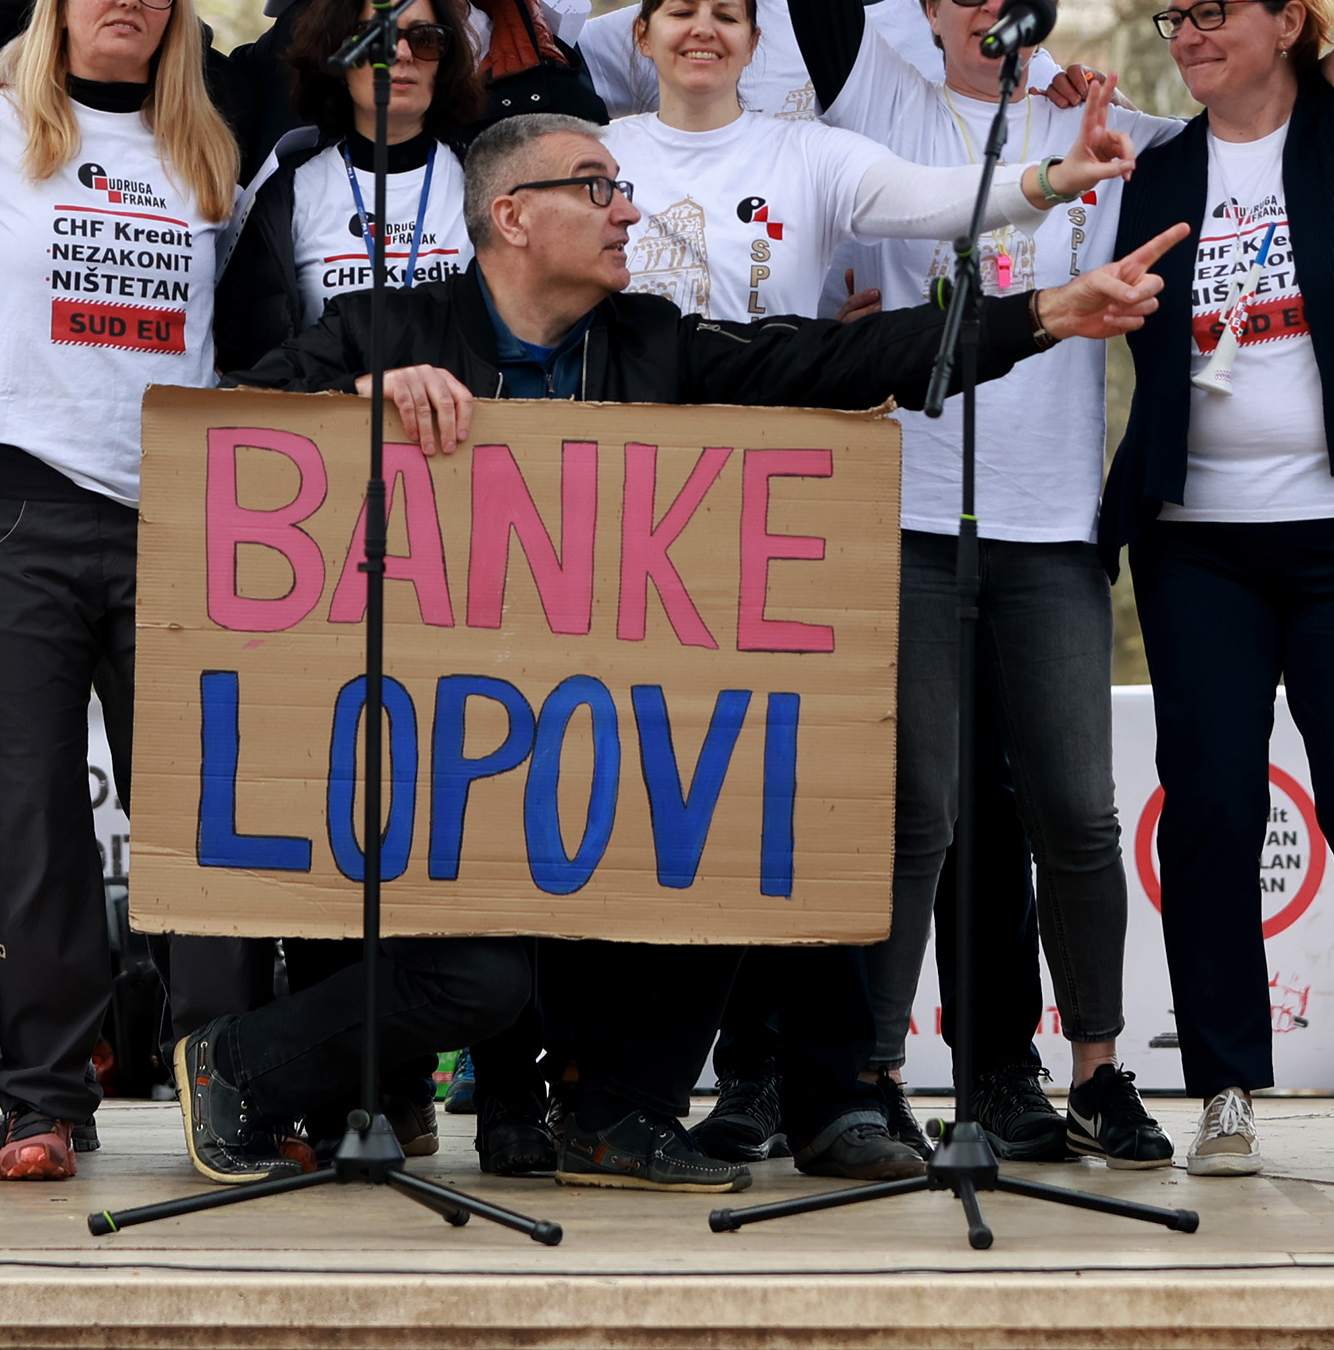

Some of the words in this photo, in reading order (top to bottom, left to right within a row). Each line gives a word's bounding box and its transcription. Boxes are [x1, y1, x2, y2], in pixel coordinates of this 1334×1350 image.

[108, 178, 154, 195] UDRUGA
[122, 193, 168, 209] FRANAK
[1239, 195, 1278, 218] URUGA
[1252, 205, 1287, 223] FRANA
[53, 217, 105, 238] CHF
[114, 221, 193, 248] Kredit
[386, 221, 416, 235] DRUG
[392, 233, 437, 245] FRAAK
[52, 243, 193, 273] NEZAKONIT
[1198, 244, 1233, 263] HF
[51, 266, 190, 303] NIŠTETAN
[322, 266, 372, 288] CHF
[69, 313, 126, 337] SUD
[137, 319, 171, 342] EU
[205, 426, 836, 653] BANKE
[197, 670, 801, 900] LOPOVI
